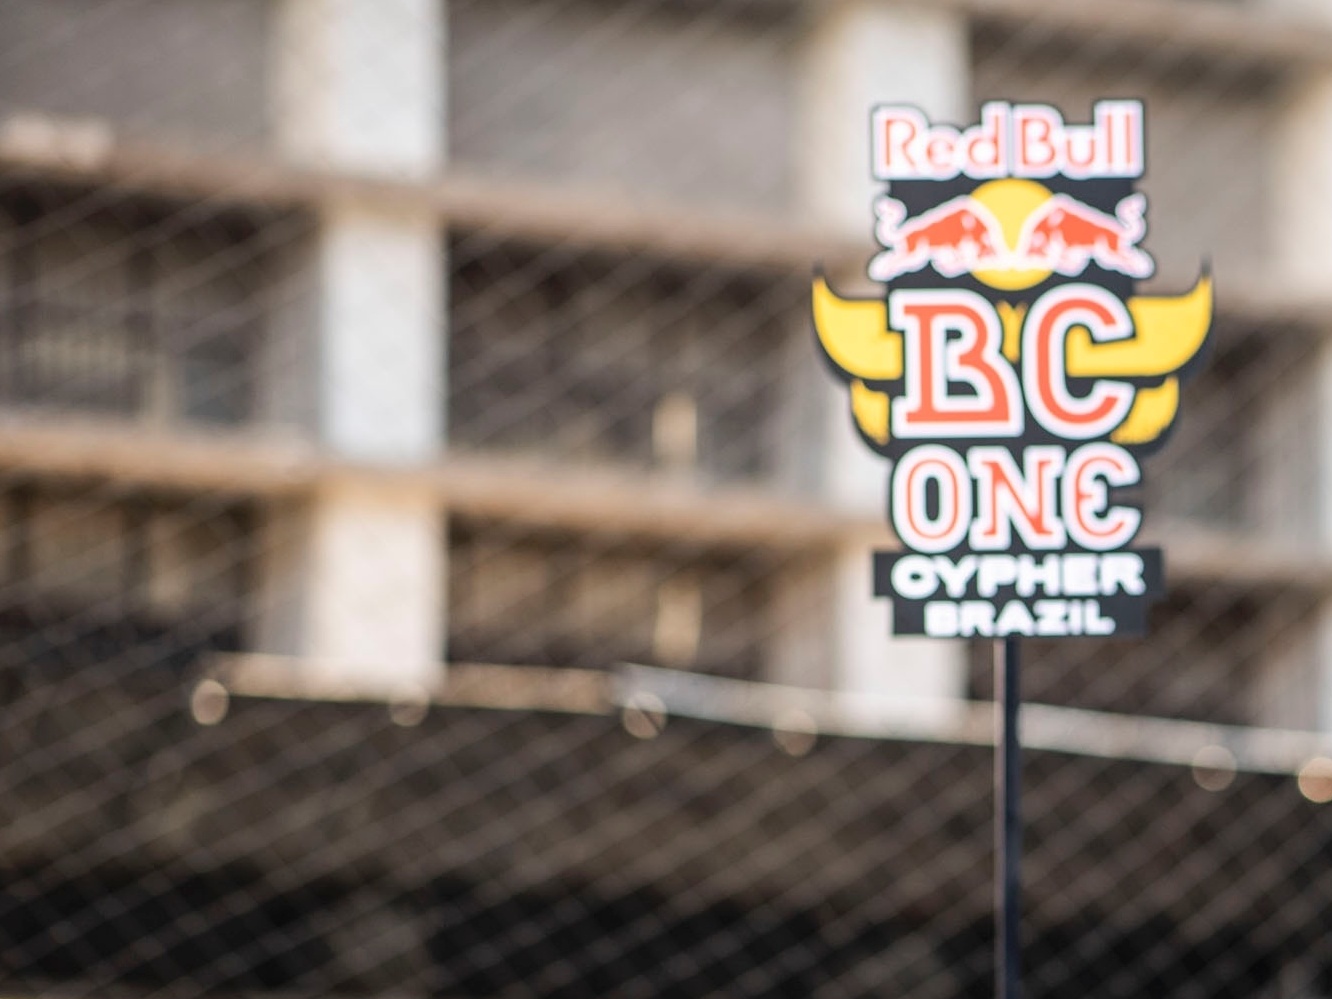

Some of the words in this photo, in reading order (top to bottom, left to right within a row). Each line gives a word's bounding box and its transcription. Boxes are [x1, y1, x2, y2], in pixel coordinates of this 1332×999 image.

[878, 106, 1004, 176] Red
[1013, 102, 1142, 177] Bull
[892, 285, 1134, 439] BC
[892, 445, 1141, 551] ONE
[891, 553, 1146, 599] CYPHER
[924, 600, 1116, 637] BRAZIL
